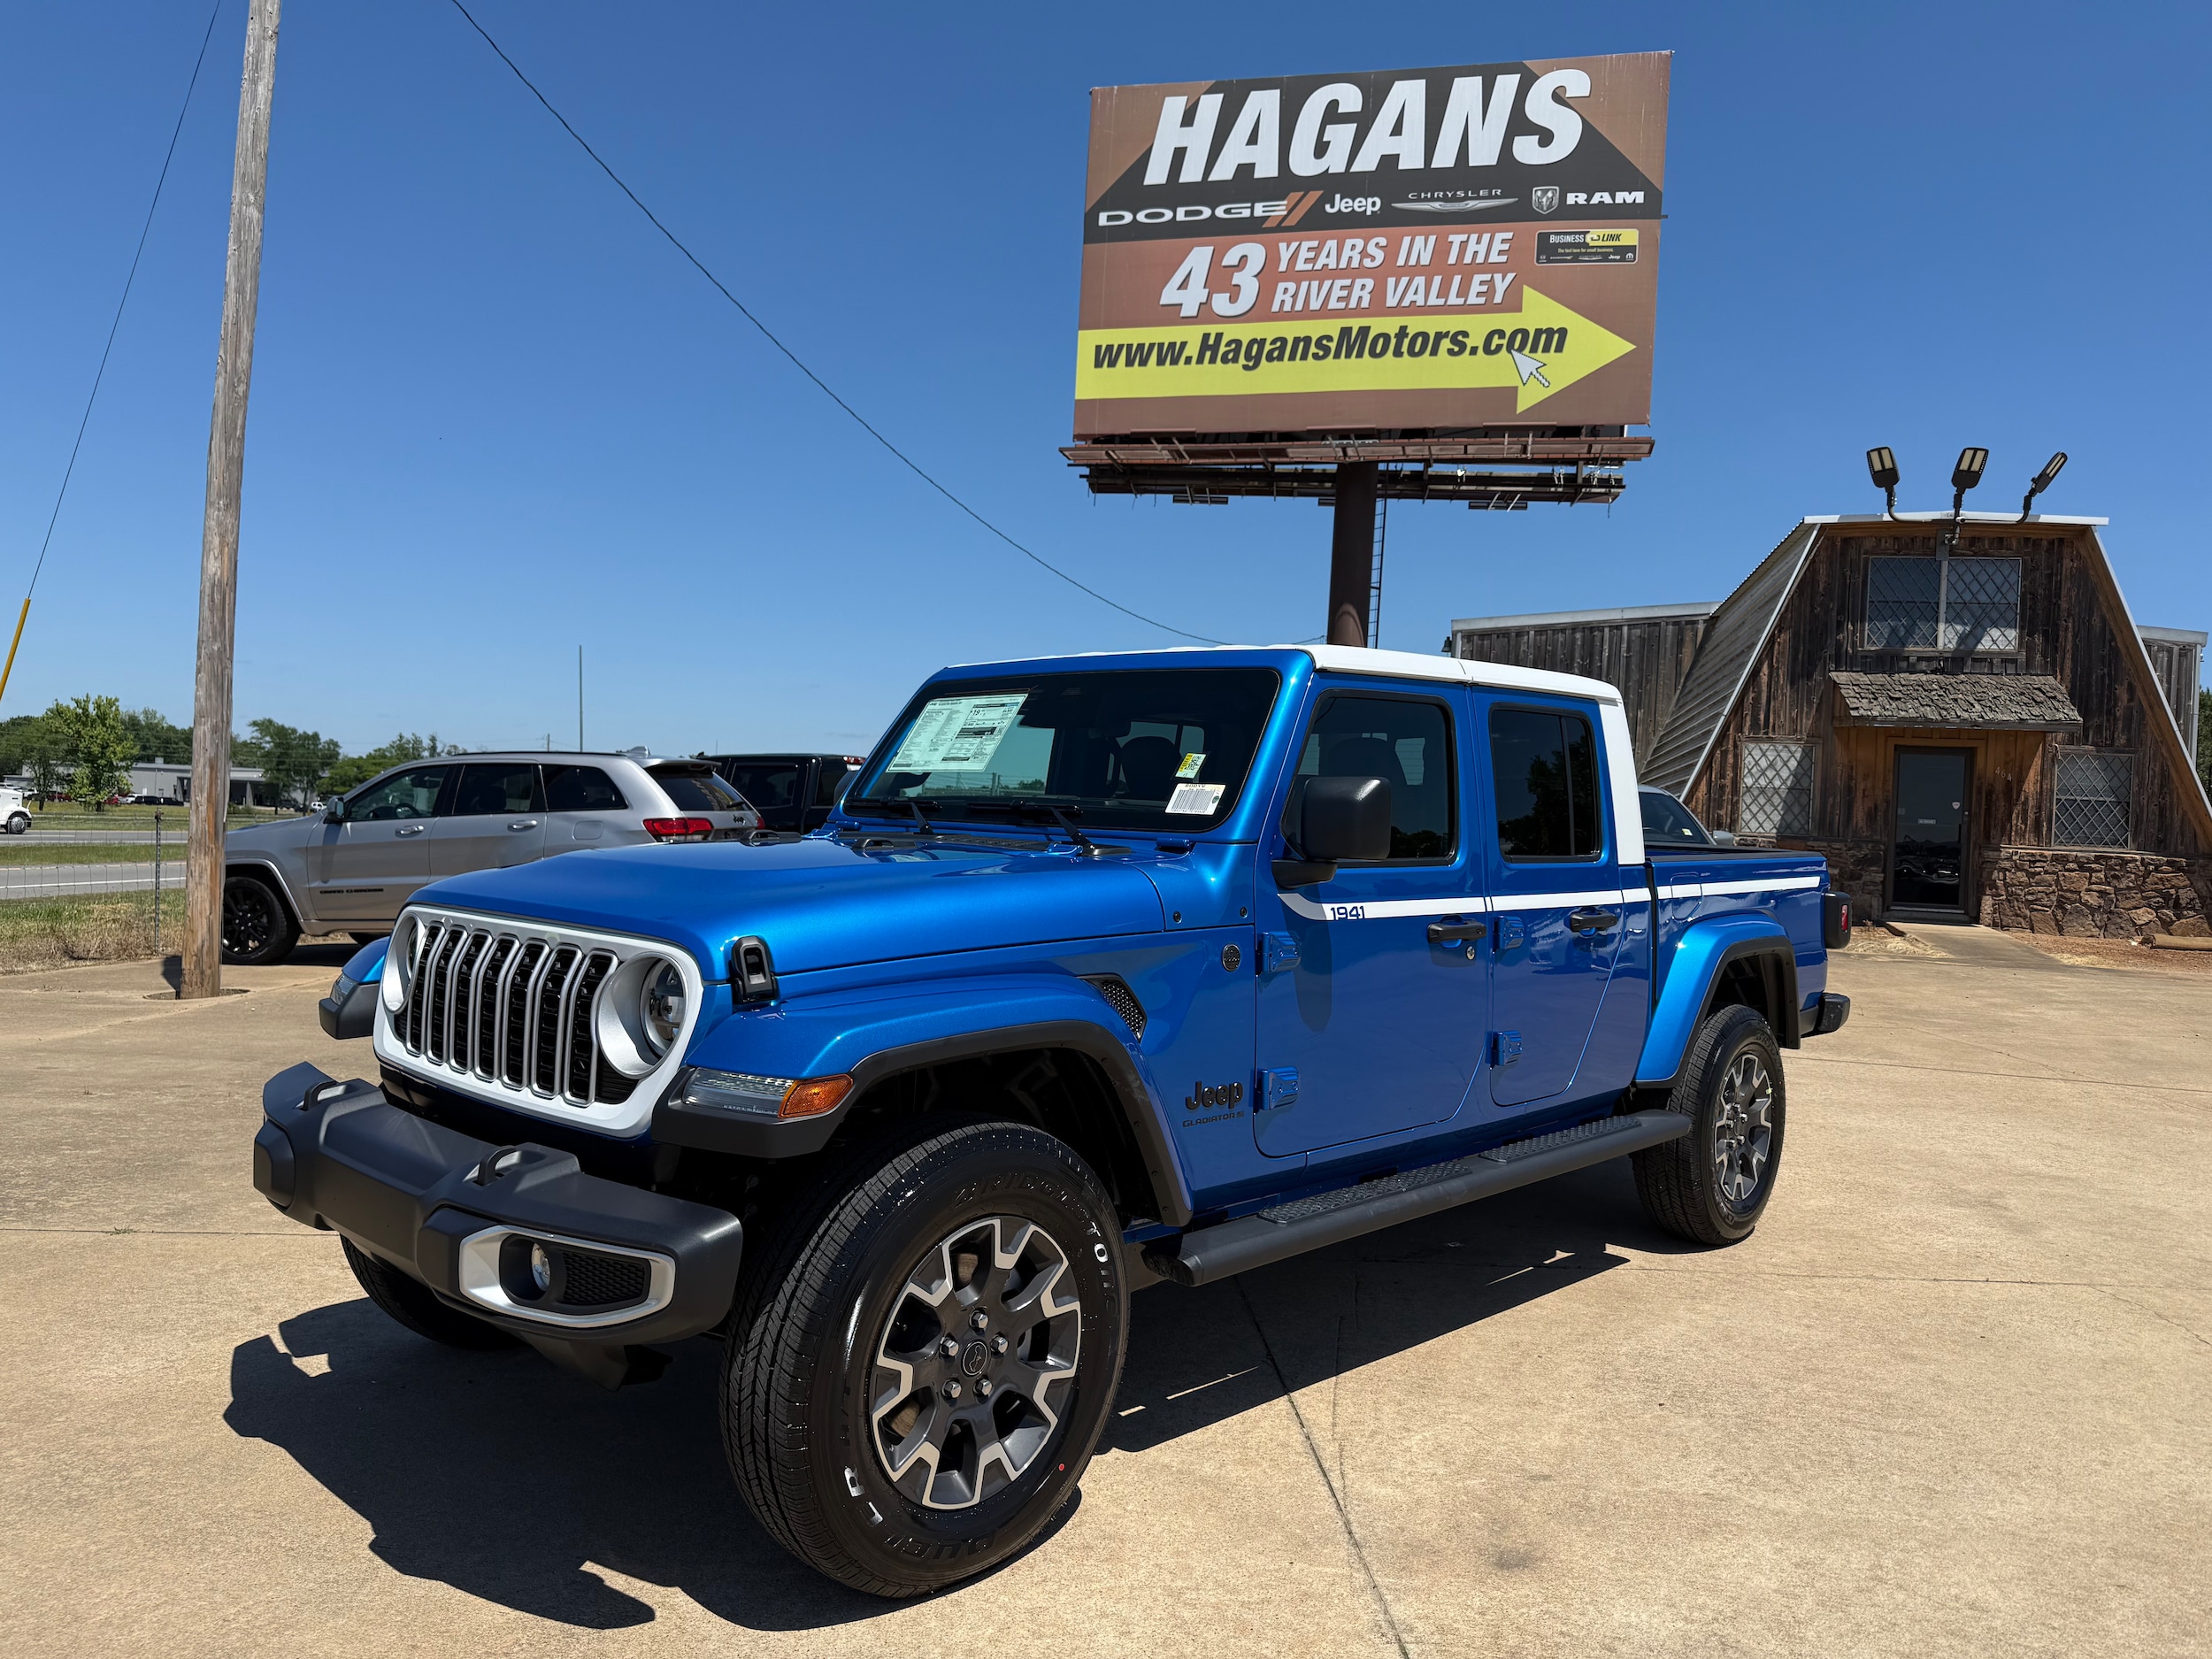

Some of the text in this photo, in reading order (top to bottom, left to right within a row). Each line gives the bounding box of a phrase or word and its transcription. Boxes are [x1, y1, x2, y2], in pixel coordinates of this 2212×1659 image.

[1143, 68, 1592, 186] HAGANS
[1325, 194, 1381, 215] Jeep
[1408, 188, 1502, 199] CHRYSLER
[1566, 191, 1645, 205] RAM
[1098, 200, 1287, 227] DODGE
[1549, 233, 1622, 243] BUSINESS LINK
[1278, 232, 1515, 273] YEARS IN THE
[1159, 242, 1267, 318] 43
[1271, 272, 1517, 313] RIVER VALLEY
[1094, 325, 1569, 372] www.HagansMotors.com
[1994, 766, 2012, 781] 464
[1331, 905, 1365, 920] 1941
[1185, 1080, 1243, 1110] Jeep
[1182, 1112, 1236, 1127] GLADIATOR
